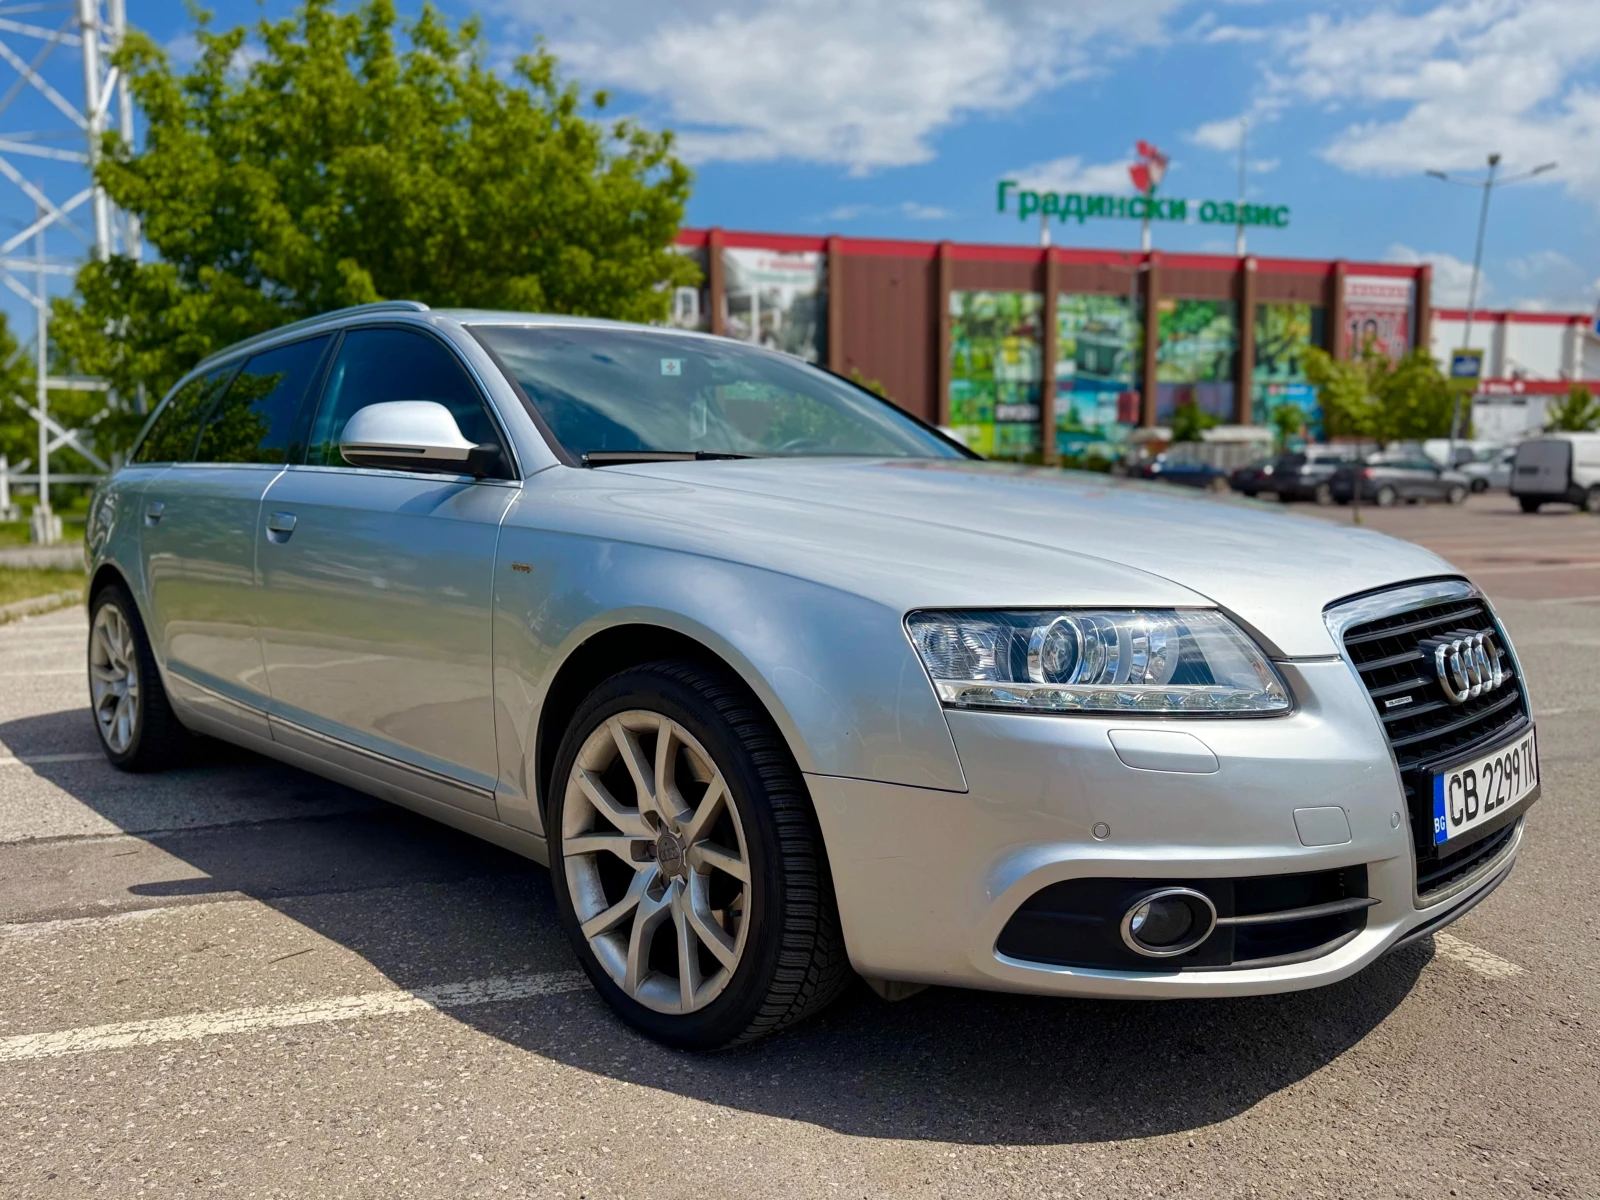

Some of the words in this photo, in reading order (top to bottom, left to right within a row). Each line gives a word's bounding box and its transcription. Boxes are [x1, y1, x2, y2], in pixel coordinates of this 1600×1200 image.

[997, 180, 1186, 224] Градински
[1449, 769, 1479, 827] CB
[1482, 748, 1520, 814] 2299
[1520, 735, 1536, 788] TK
[1433, 816, 1446, 834] BG
